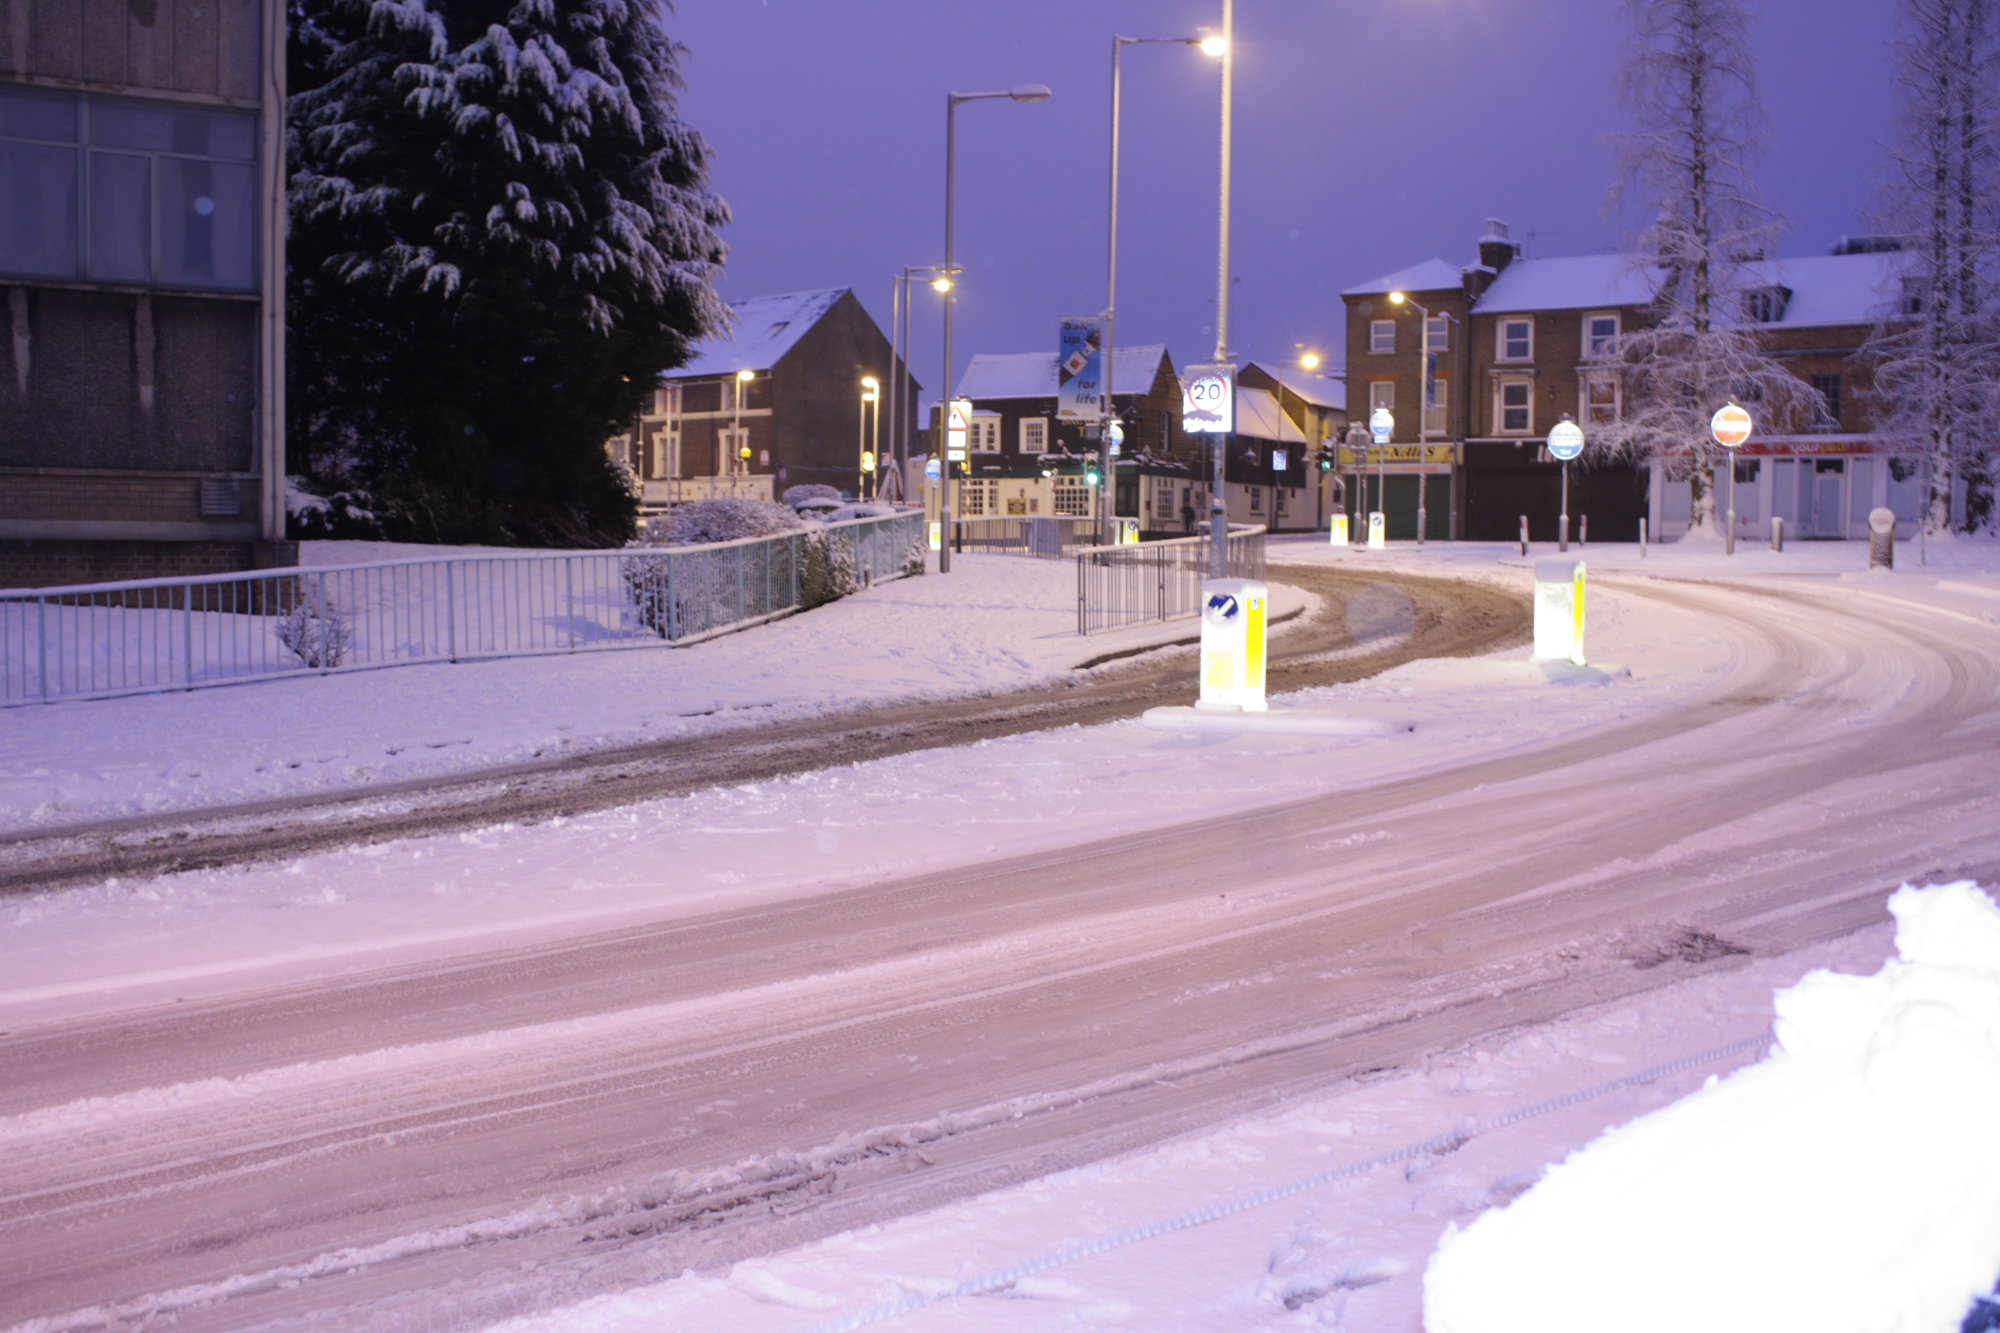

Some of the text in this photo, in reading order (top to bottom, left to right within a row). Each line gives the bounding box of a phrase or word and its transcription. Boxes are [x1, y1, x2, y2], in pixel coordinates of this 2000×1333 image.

[1063, 336, 1080, 346] up
[1077, 379, 1097, 389] for
[1194, 384, 1221, 400] 20
[1076, 393, 1097, 404] life
